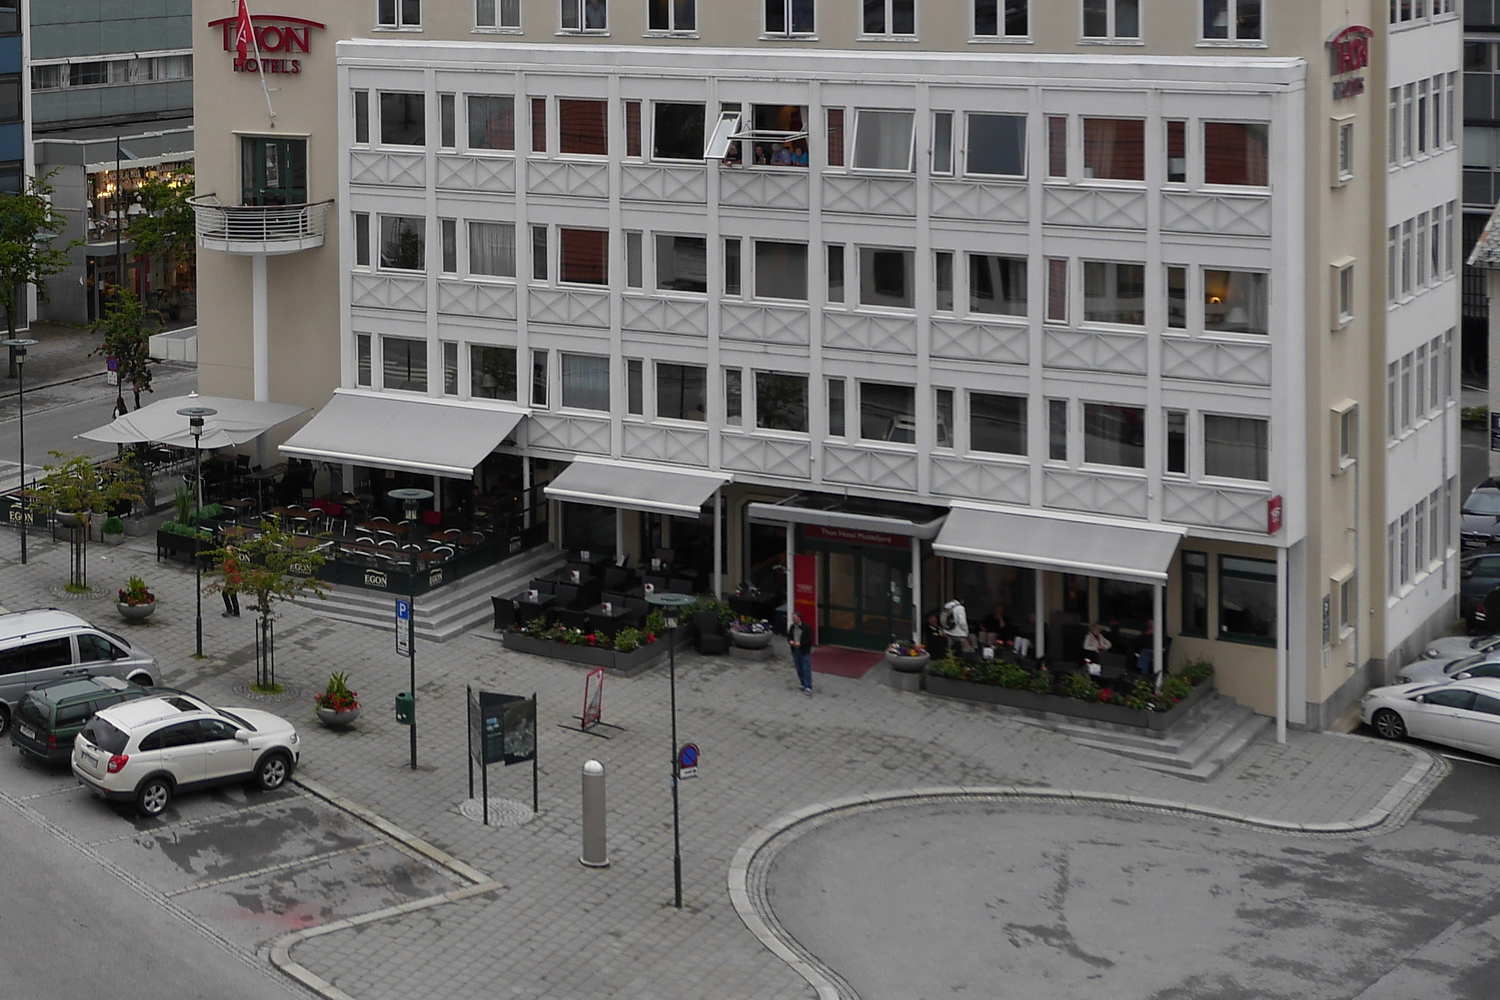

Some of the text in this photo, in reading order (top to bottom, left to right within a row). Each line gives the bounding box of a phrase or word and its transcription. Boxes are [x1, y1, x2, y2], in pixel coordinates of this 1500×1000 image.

[233, 57, 301, 74] HOTELS
[364, 574, 387, 587] EGON
[399, 602, 407, 617] P
